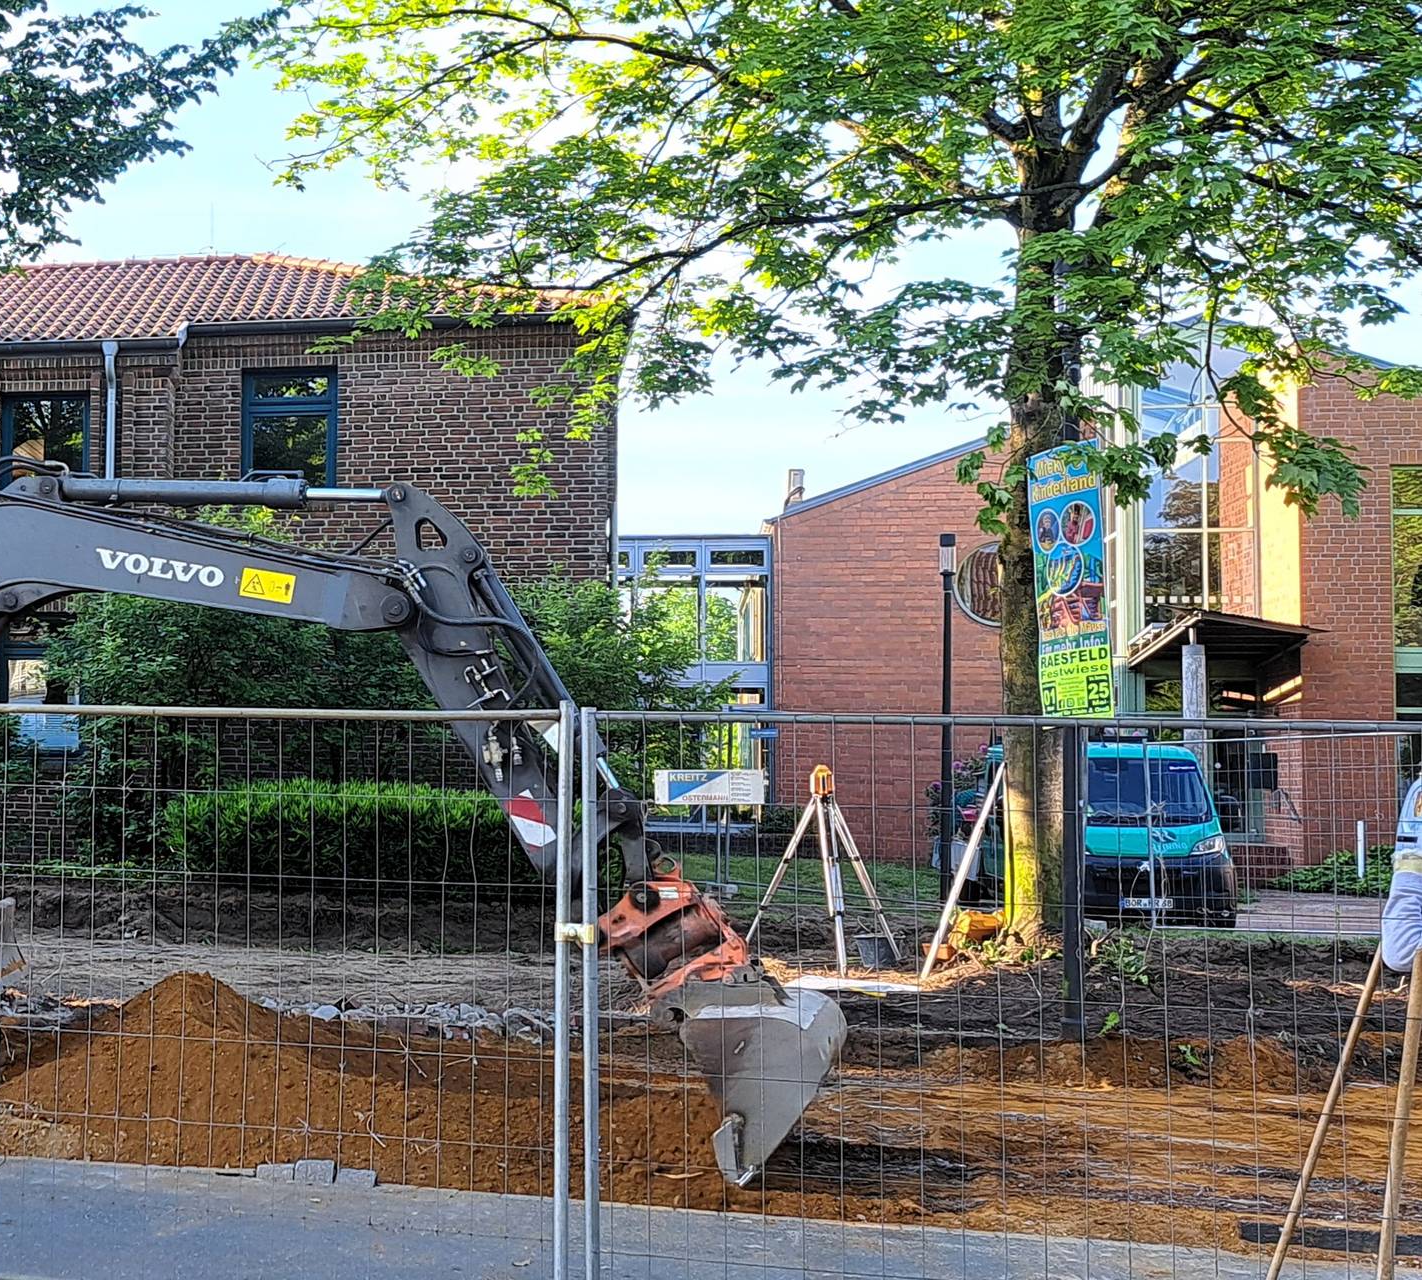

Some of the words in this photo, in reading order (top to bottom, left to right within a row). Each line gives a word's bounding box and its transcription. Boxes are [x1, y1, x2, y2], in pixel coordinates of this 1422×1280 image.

[95, 548, 225, 588] VOLVO
[1041, 647, 1108, 669] RAESFELD
[1041, 663, 1109, 680] Festwiese
[1044, 687, 1056, 706] 01
[1088, 681, 1110, 700] 25
[669, 773, 707, 782] KREITZ
